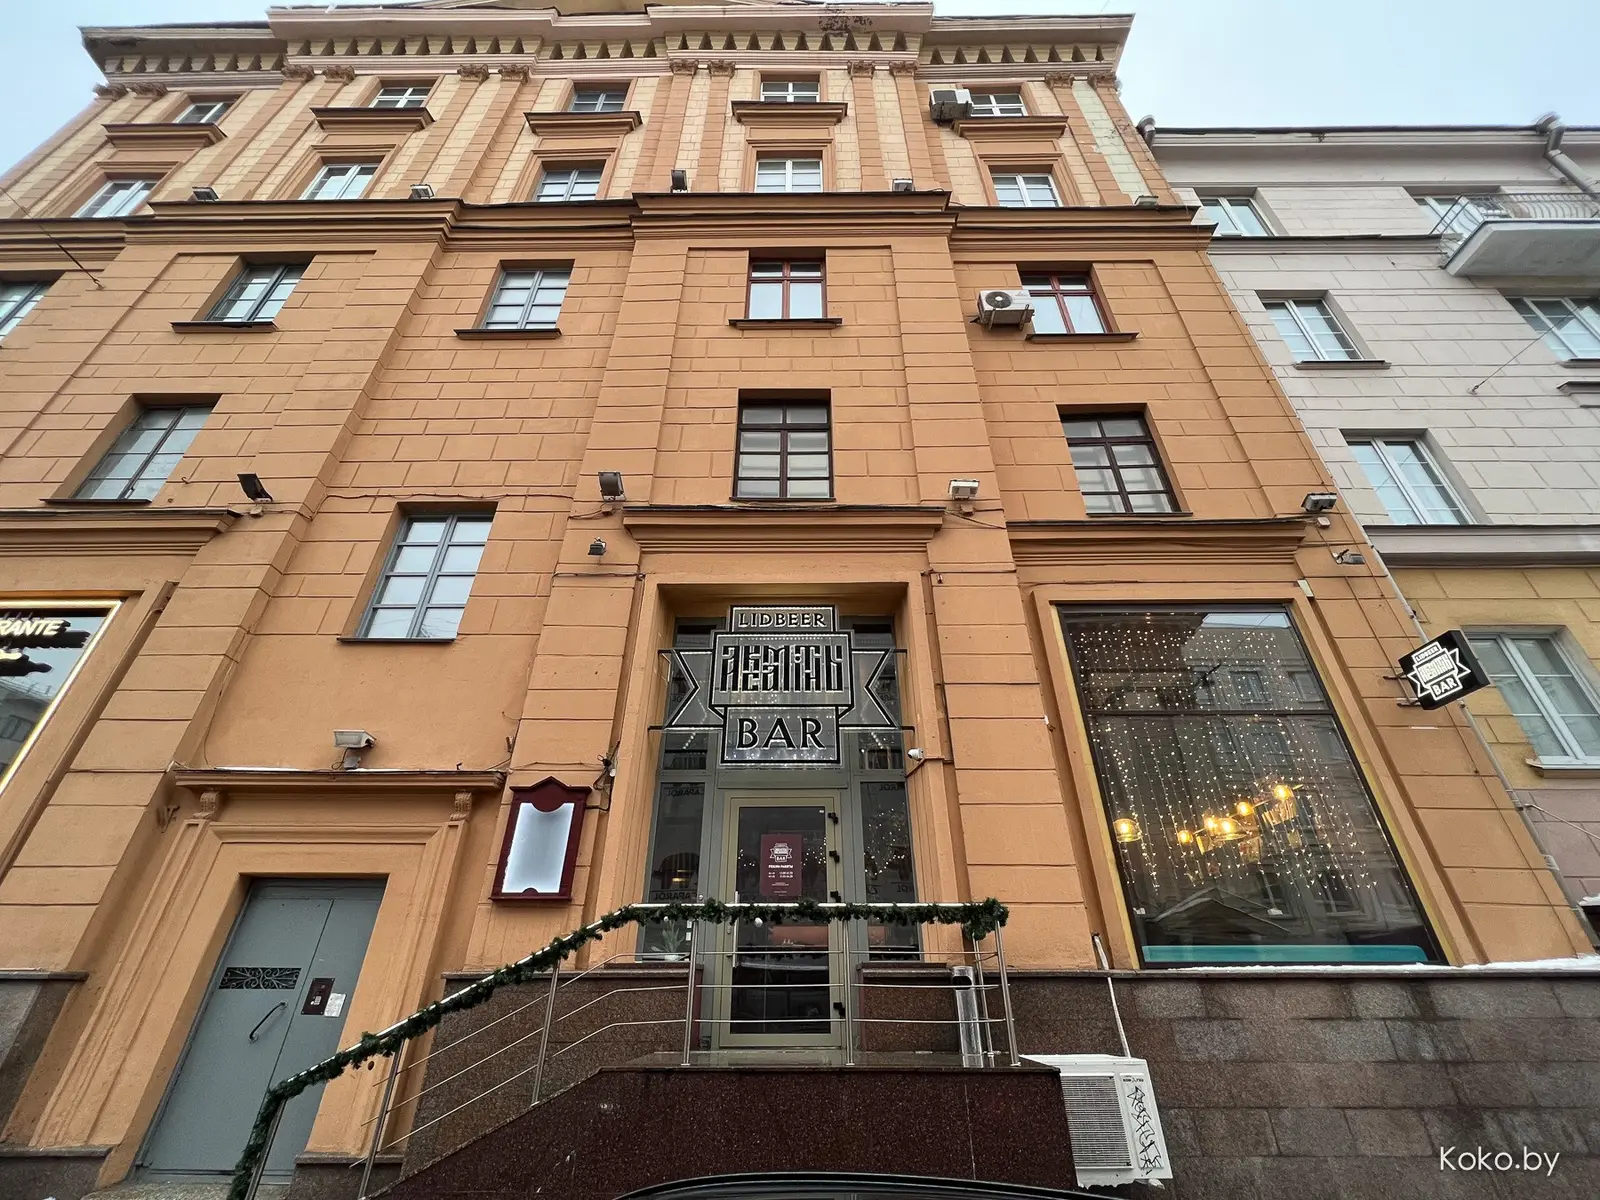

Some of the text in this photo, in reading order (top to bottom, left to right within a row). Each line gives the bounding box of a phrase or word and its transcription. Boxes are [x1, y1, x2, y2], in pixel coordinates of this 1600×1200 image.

[738, 612, 827, 628] LIDBEER
[1431, 677, 1458, 696] BAR
[736, 717, 826, 750] BAR
